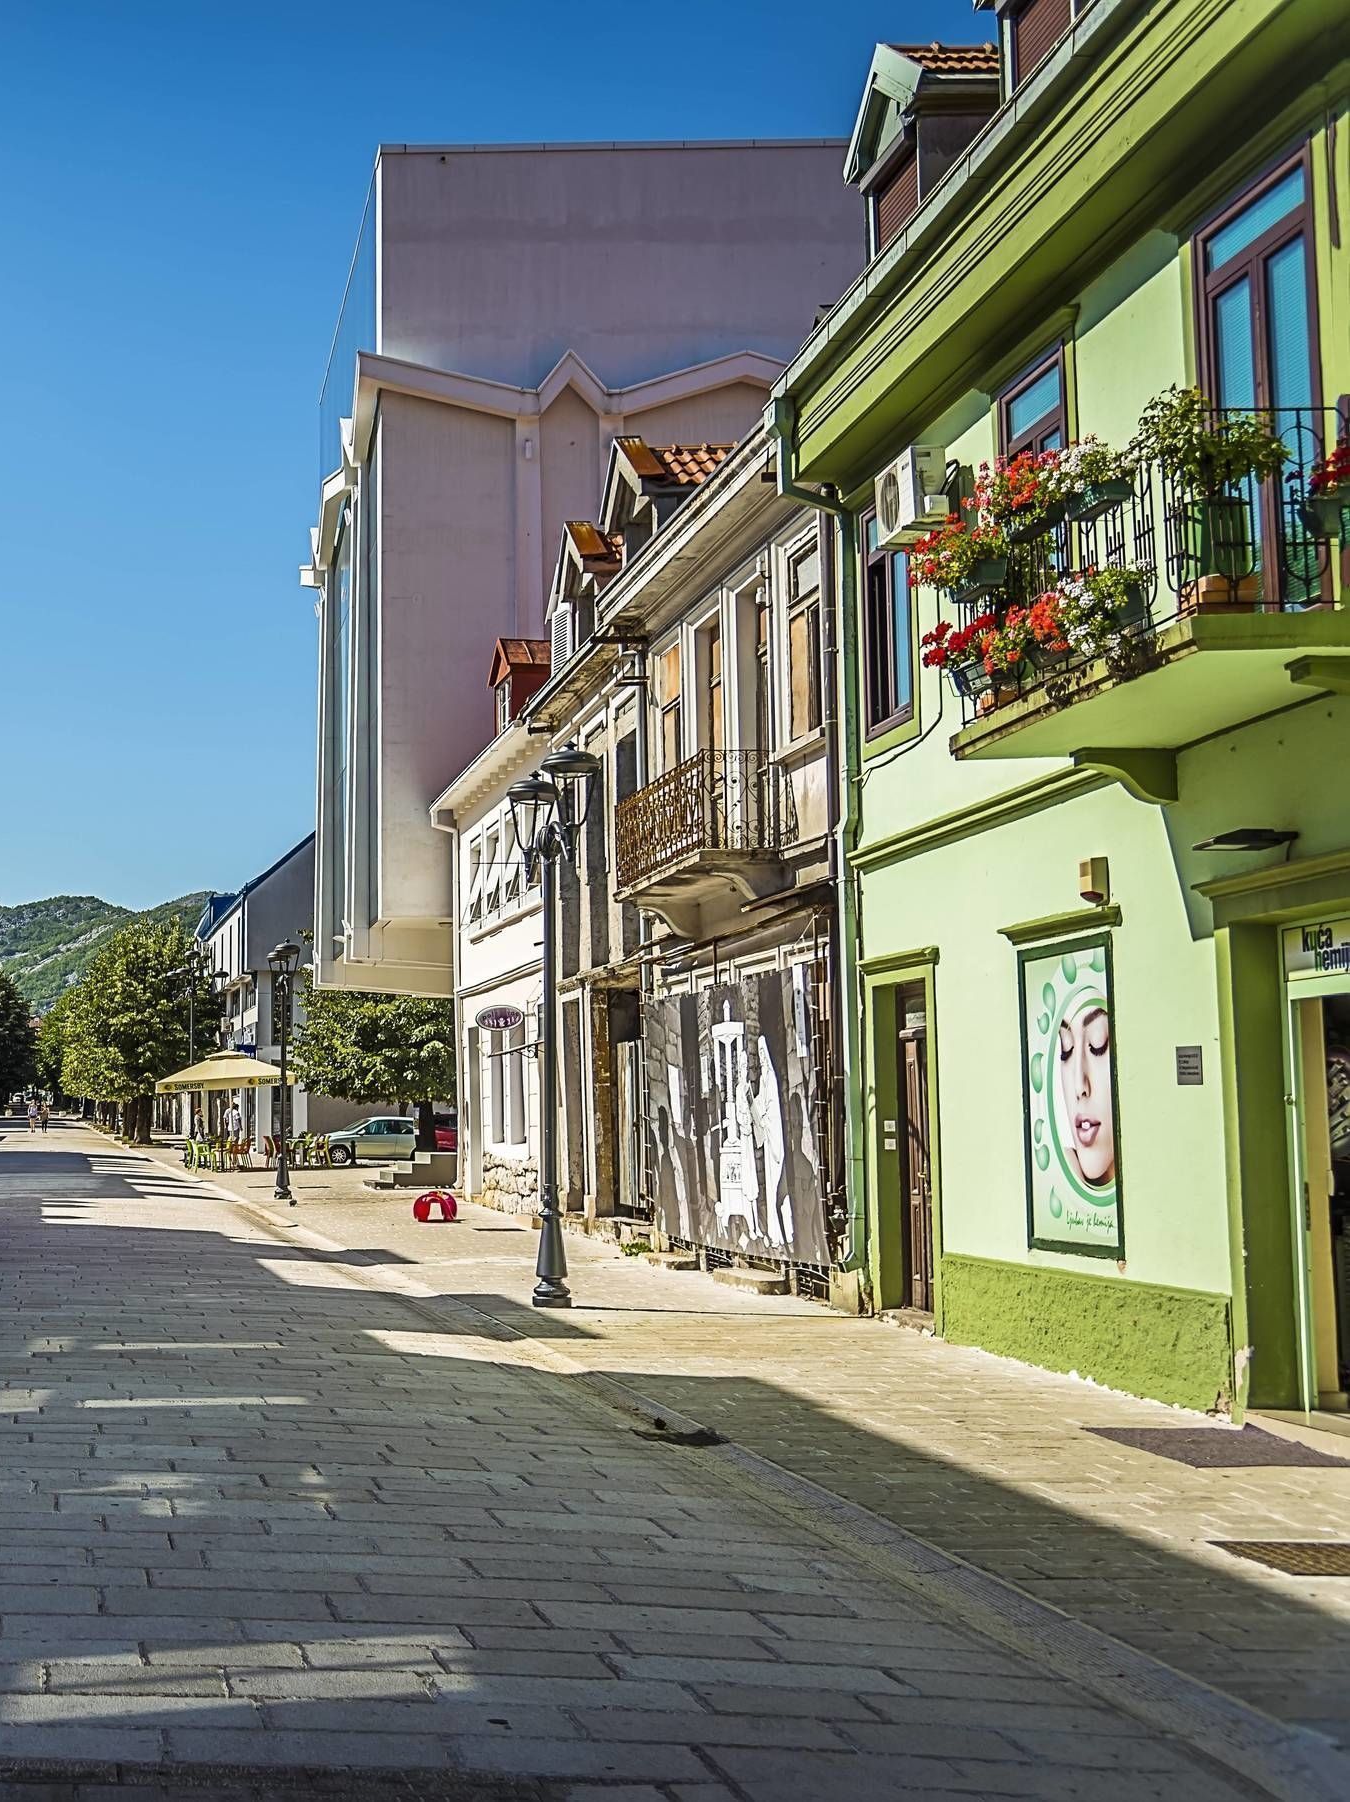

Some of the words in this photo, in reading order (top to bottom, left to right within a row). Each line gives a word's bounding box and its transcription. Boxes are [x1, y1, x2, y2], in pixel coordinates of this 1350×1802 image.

[1302, 924, 1333, 952] kuća
[258, 1077, 287, 1086] SOMERS
[174, 1083, 204, 1091] SOMERSBY
